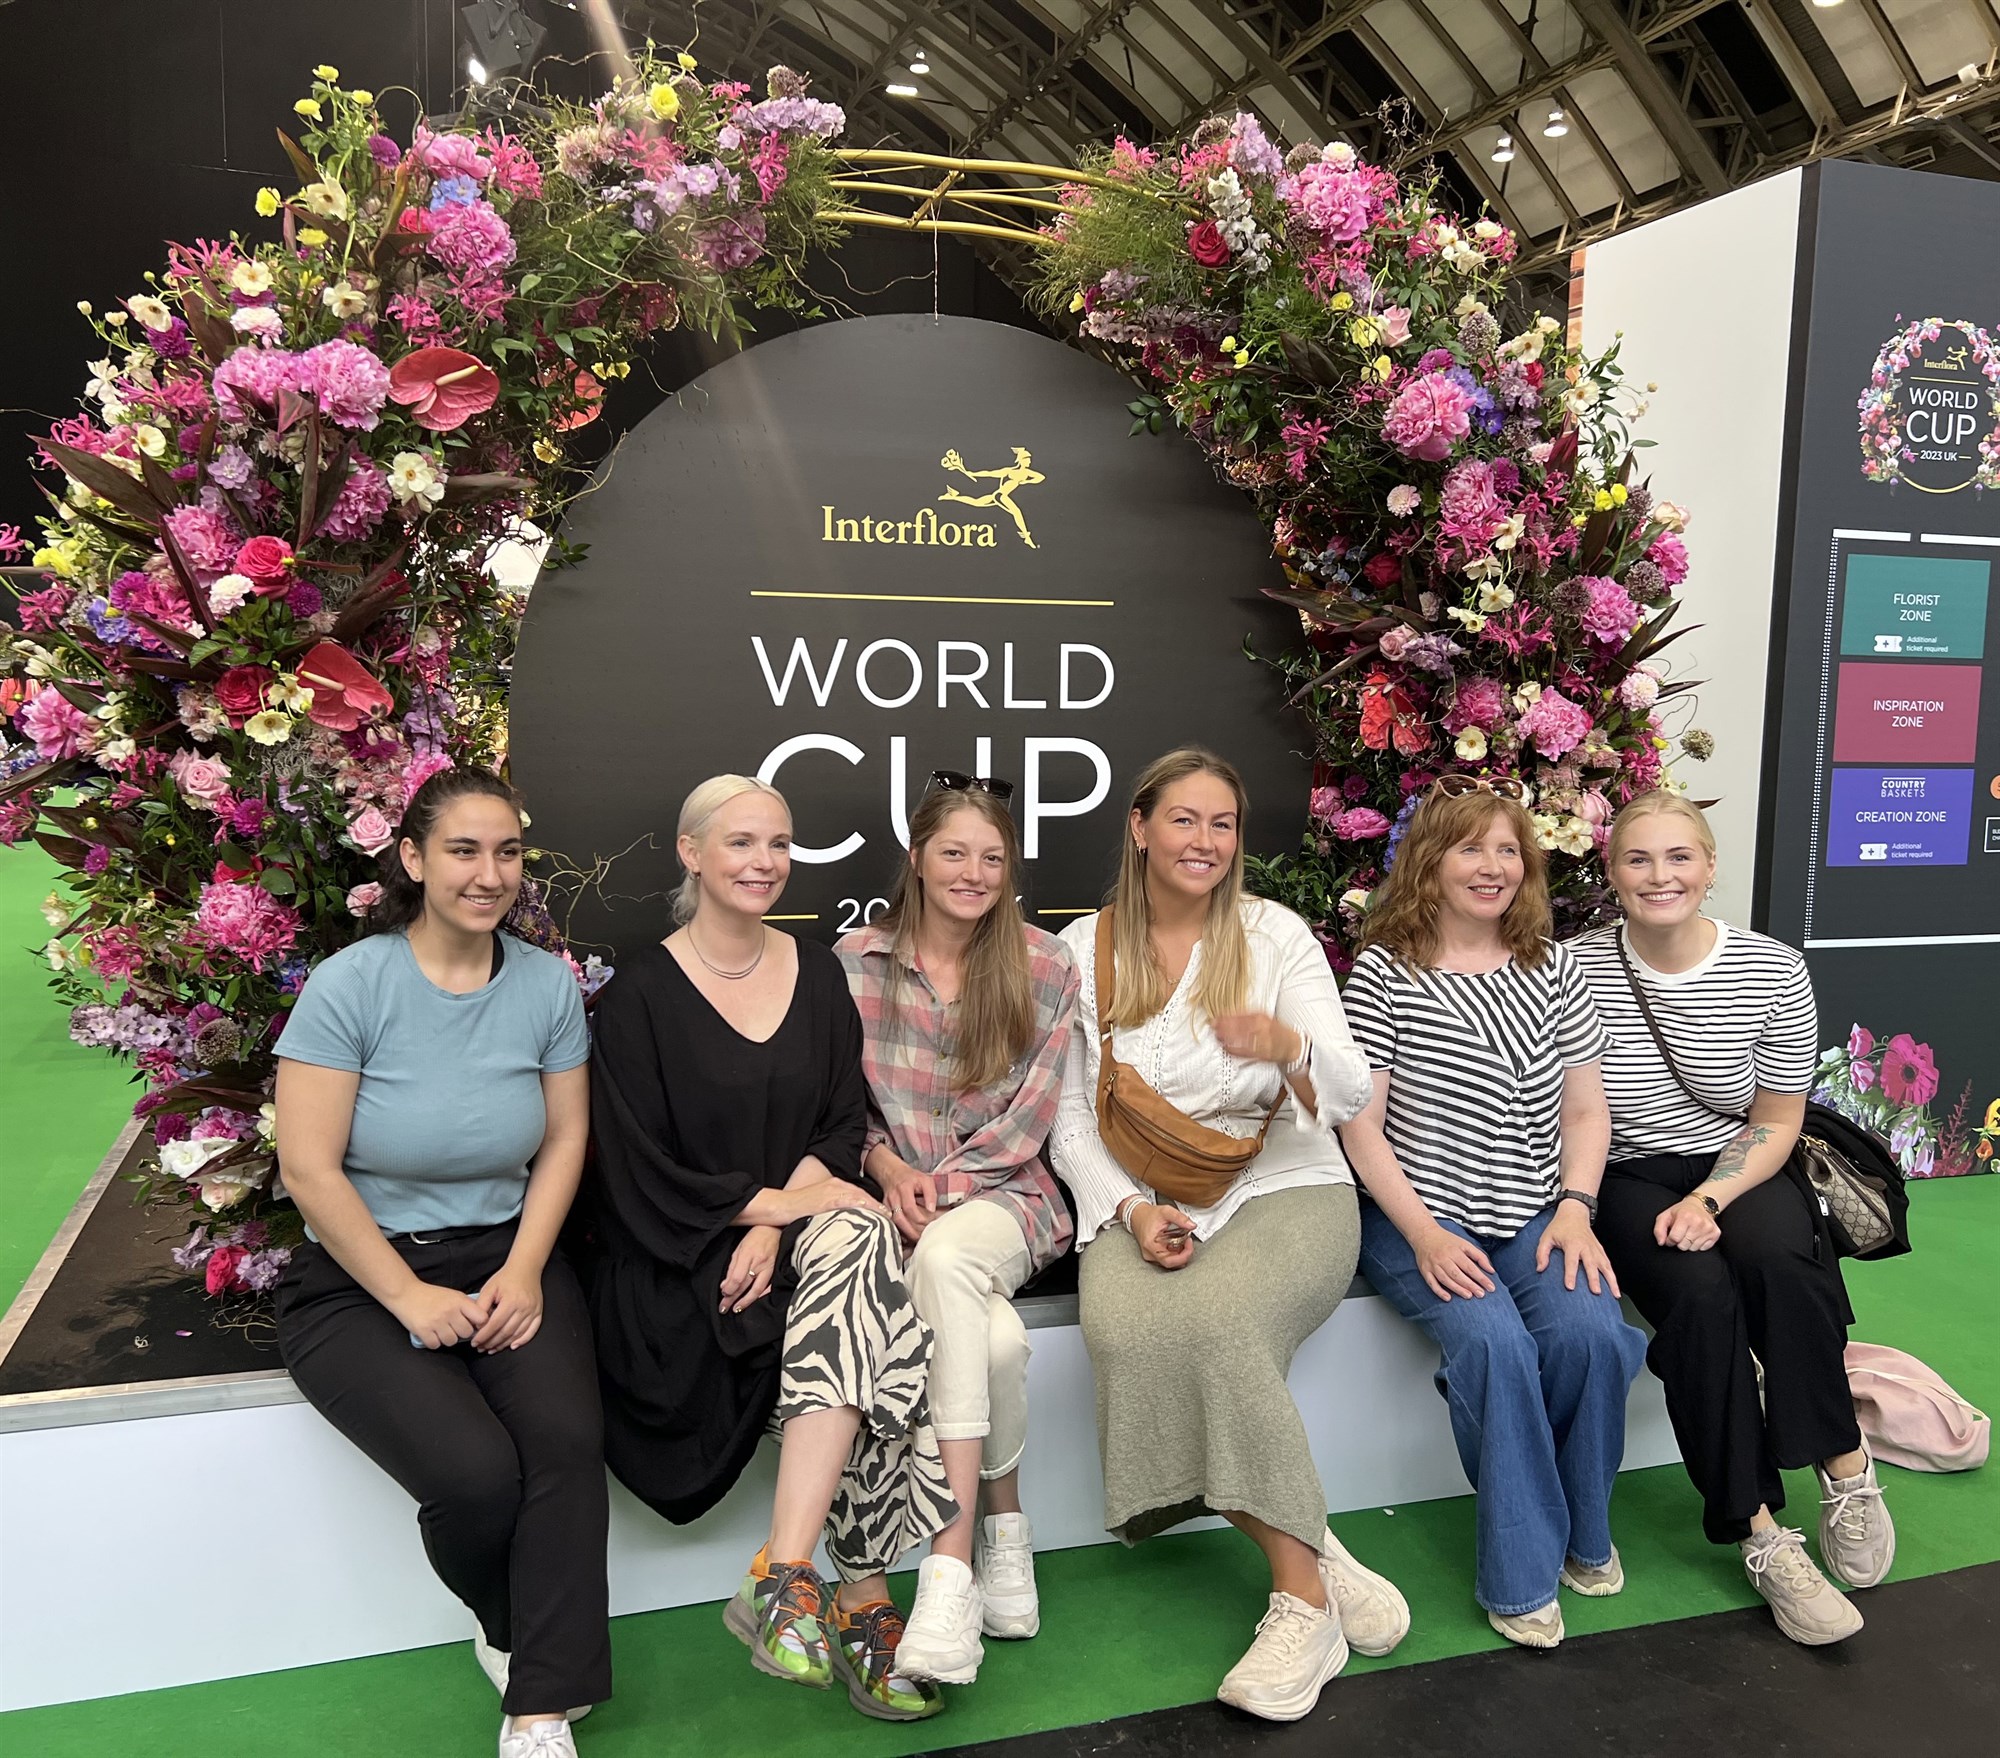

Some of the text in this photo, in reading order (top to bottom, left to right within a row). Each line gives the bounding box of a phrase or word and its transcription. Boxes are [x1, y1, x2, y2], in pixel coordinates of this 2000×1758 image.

[1909, 387, 1978, 410] WORLD
[1906, 410, 1977, 445] CUP
[1920, 450, 1958, 461] 2023 UK
[821, 505, 998, 548] Interflora
[1893, 593, 1940, 605] FLORIST
[1899, 609, 1932, 621] ZONE
[750, 636, 1115, 709] WORLD
[1873, 700, 1944, 712] INSPIRATION
[1891, 716, 1924, 728] ZONE
[1881, 780, 1926, 788] COUNTRY
[1880, 789, 1926, 798] BASKETS
[1855, 811, 1947, 823] CREATION ZONE
